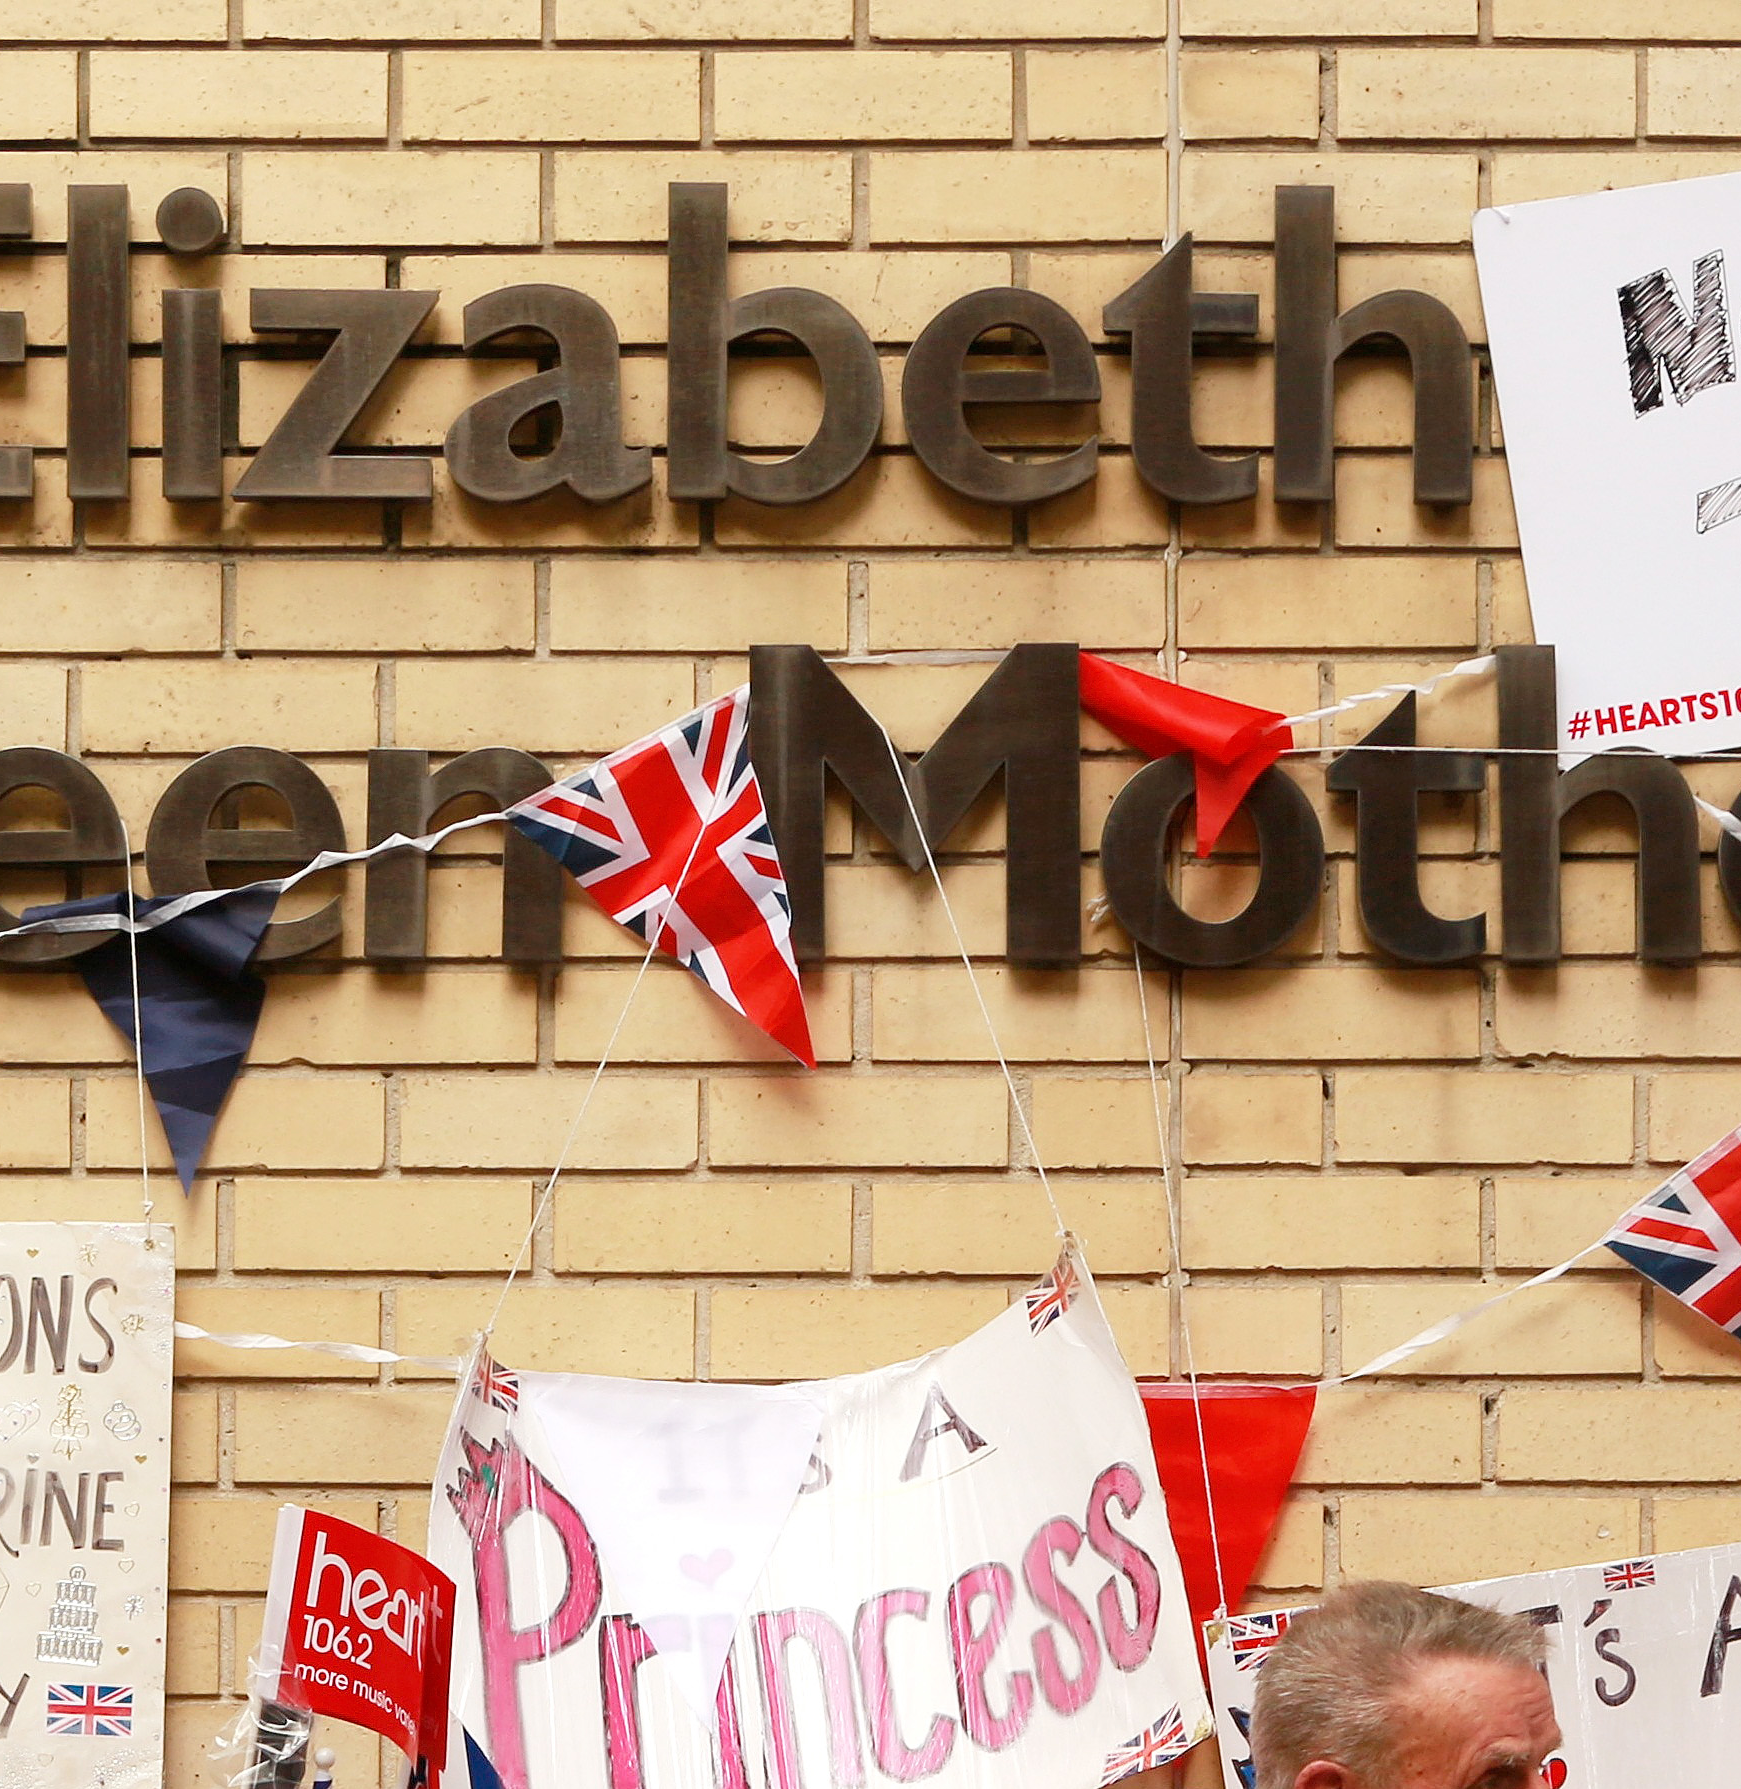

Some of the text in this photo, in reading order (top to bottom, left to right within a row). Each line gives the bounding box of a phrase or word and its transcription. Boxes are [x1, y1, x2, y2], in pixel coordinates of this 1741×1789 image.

[899, 1380, 998, 1482] A
[306, 1531, 427, 1672] heart
[303, 1614, 372, 1669] 106.2
[294, 1663, 348, 1690] more
[353, 1678, 393, 1713] music
